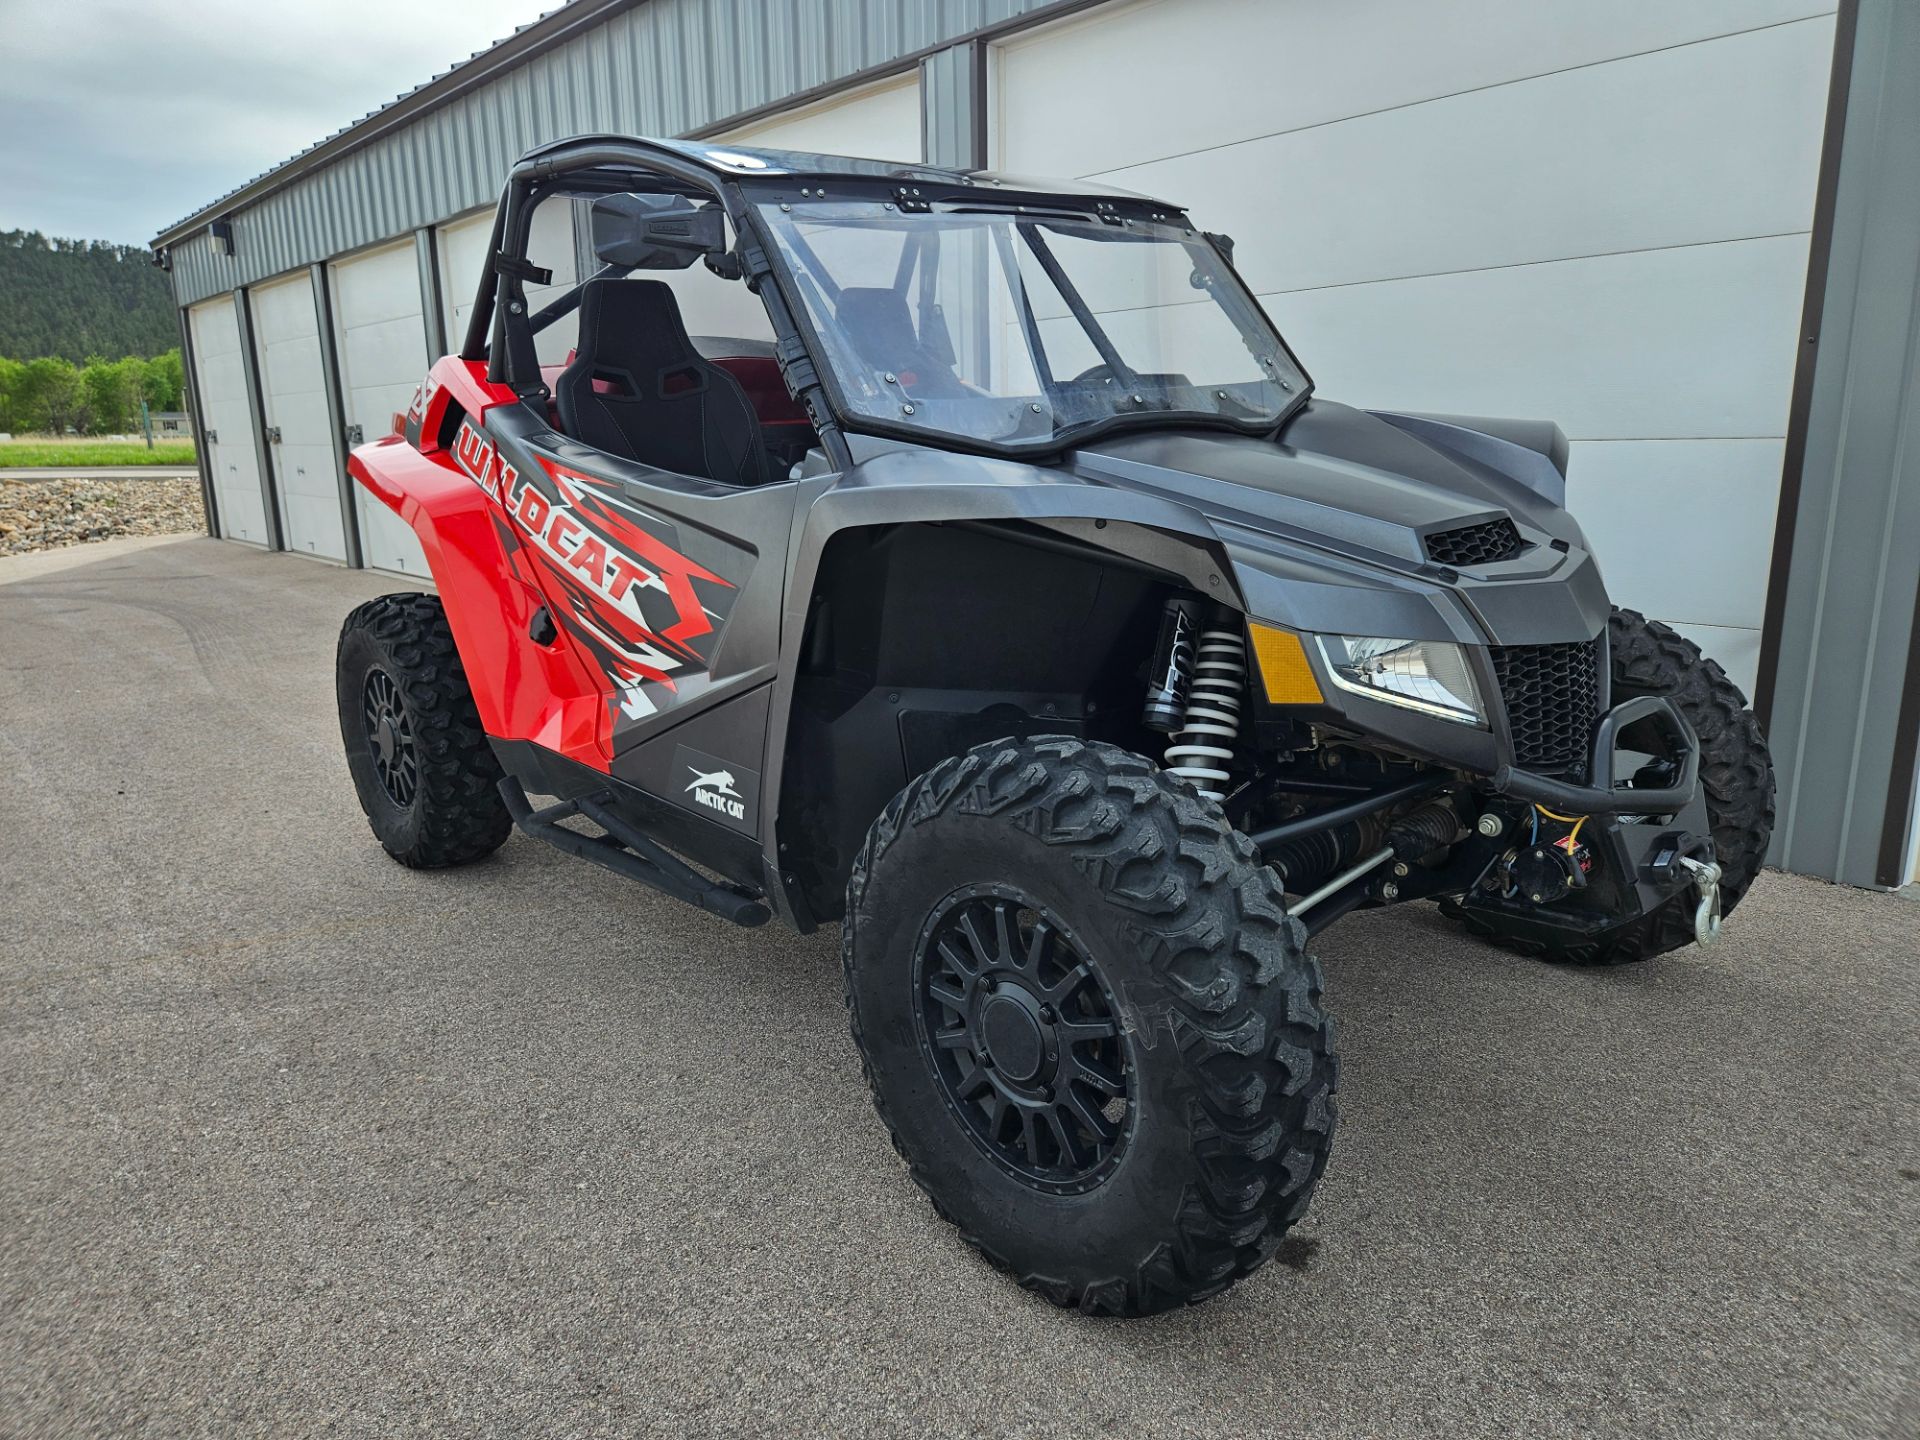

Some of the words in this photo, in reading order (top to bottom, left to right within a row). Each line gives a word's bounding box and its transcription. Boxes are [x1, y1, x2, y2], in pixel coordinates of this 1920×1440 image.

[458, 421, 652, 602] WILDCAT
[1164, 608, 1198, 699] FOX
[695, 787, 727, 813] ARCTIC
[727, 800, 745, 820] CAT
